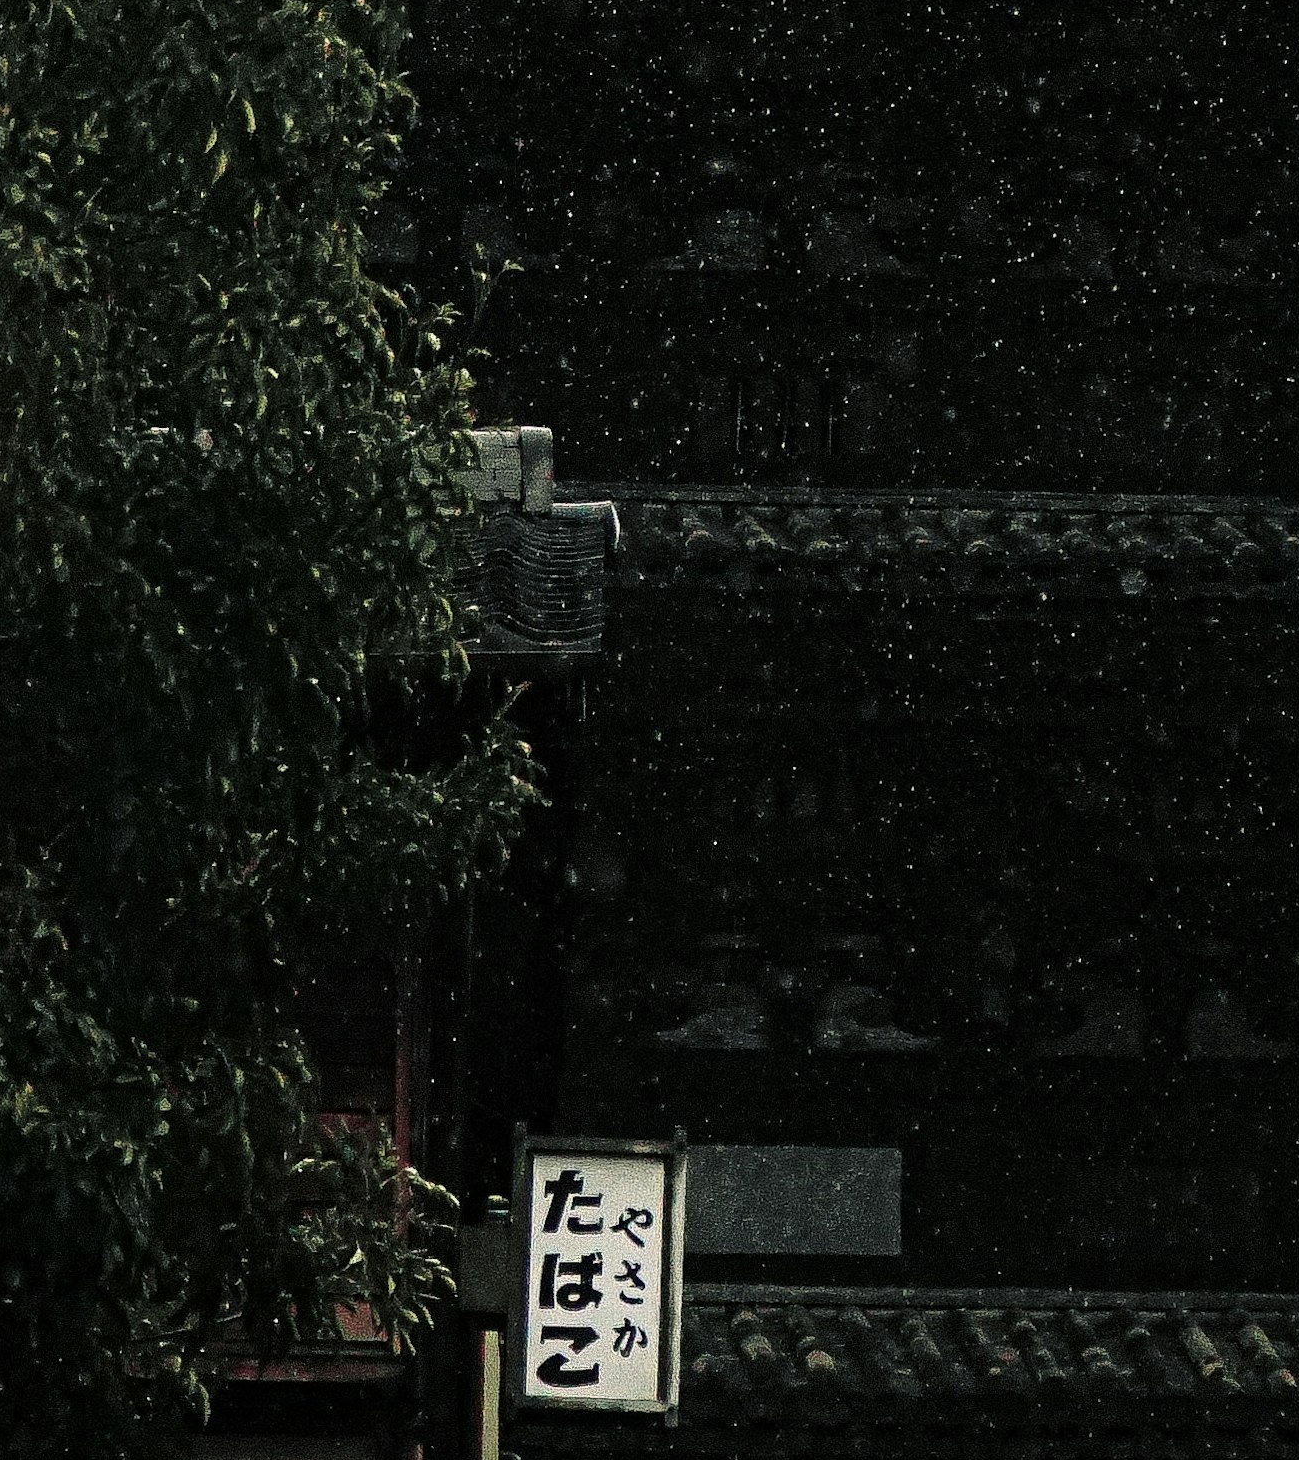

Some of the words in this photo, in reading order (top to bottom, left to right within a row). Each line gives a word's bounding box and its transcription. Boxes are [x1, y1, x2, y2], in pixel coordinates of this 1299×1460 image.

[537, 1170, 603, 1387] たばこ
[610, 1208, 653, 1357] やさか
